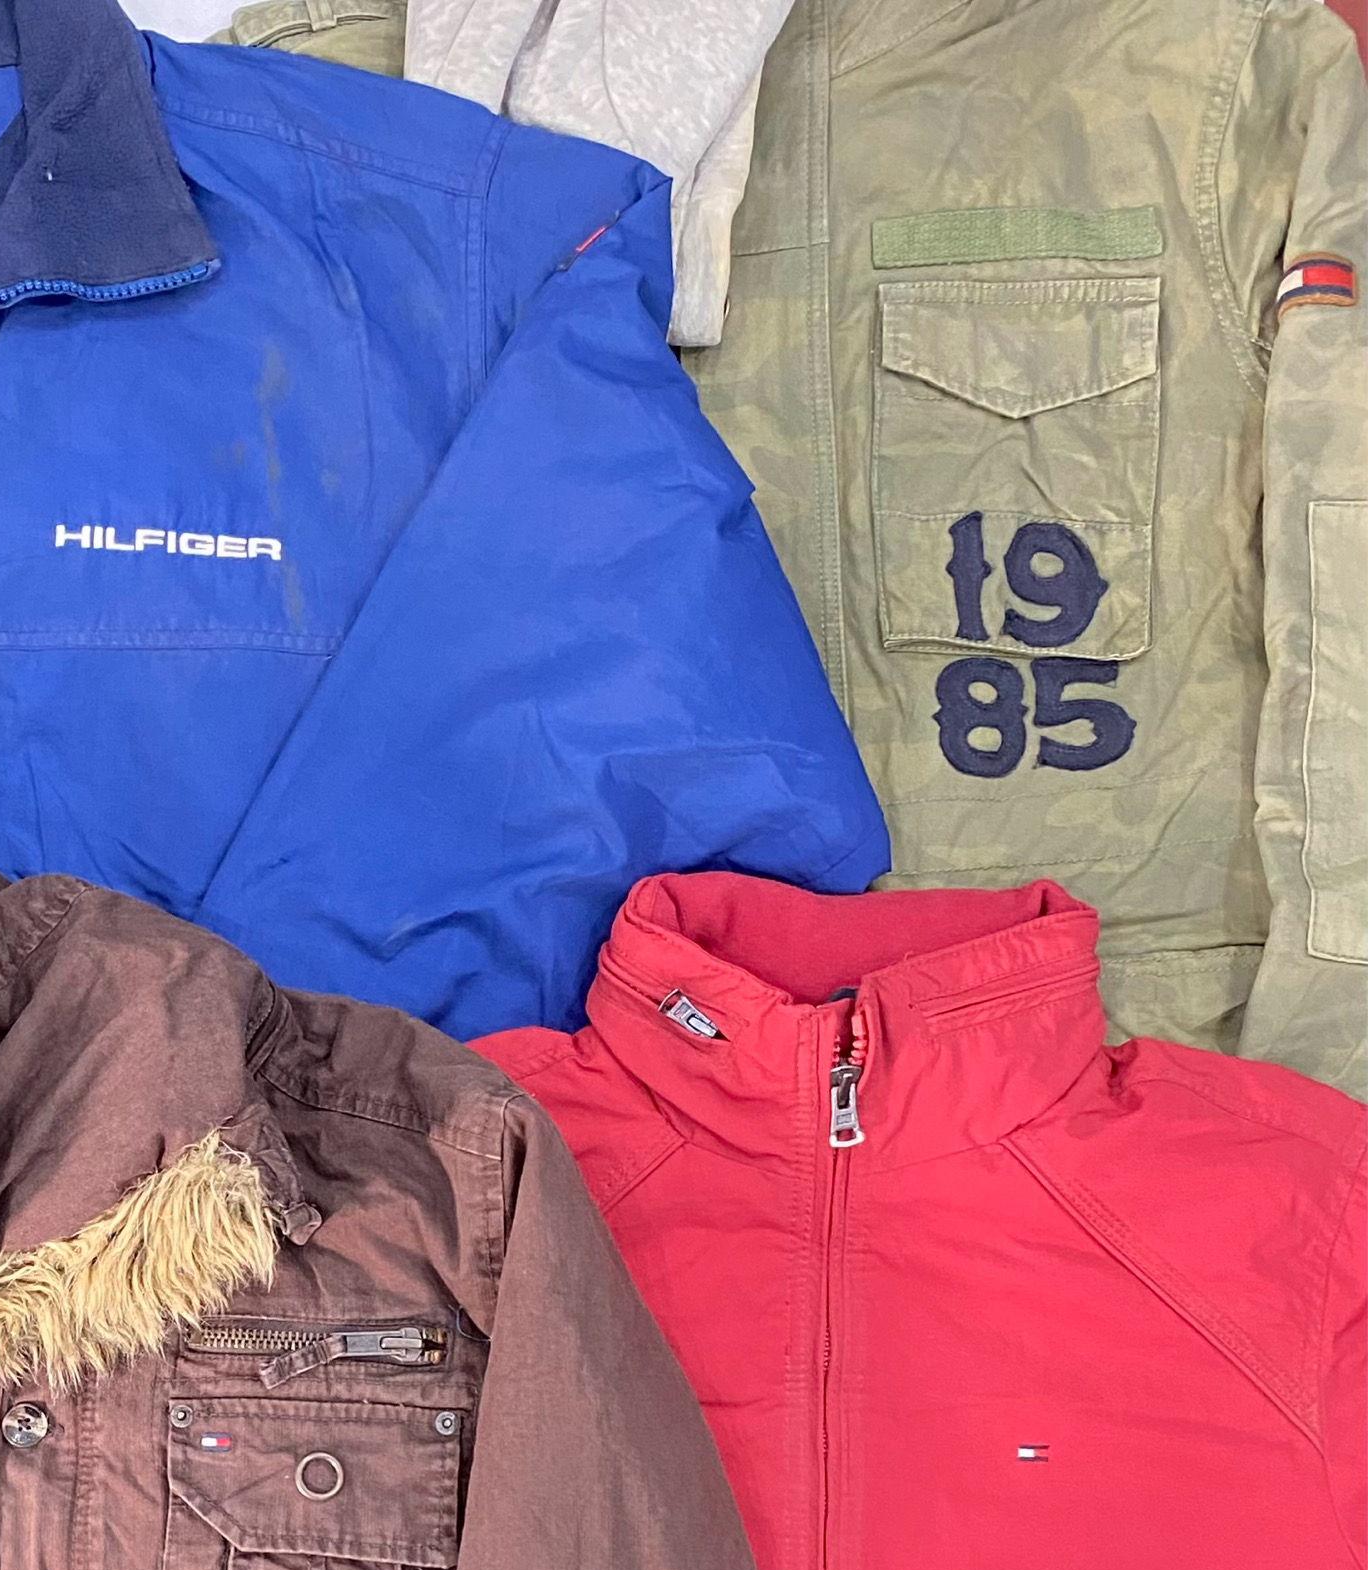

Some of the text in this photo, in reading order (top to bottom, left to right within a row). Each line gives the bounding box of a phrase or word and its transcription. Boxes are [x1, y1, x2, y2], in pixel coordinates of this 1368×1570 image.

[55, 524, 282, 560] HILFIGER
[945, 510, 1110, 648] 19
[932, 657, 1138, 779] 85
